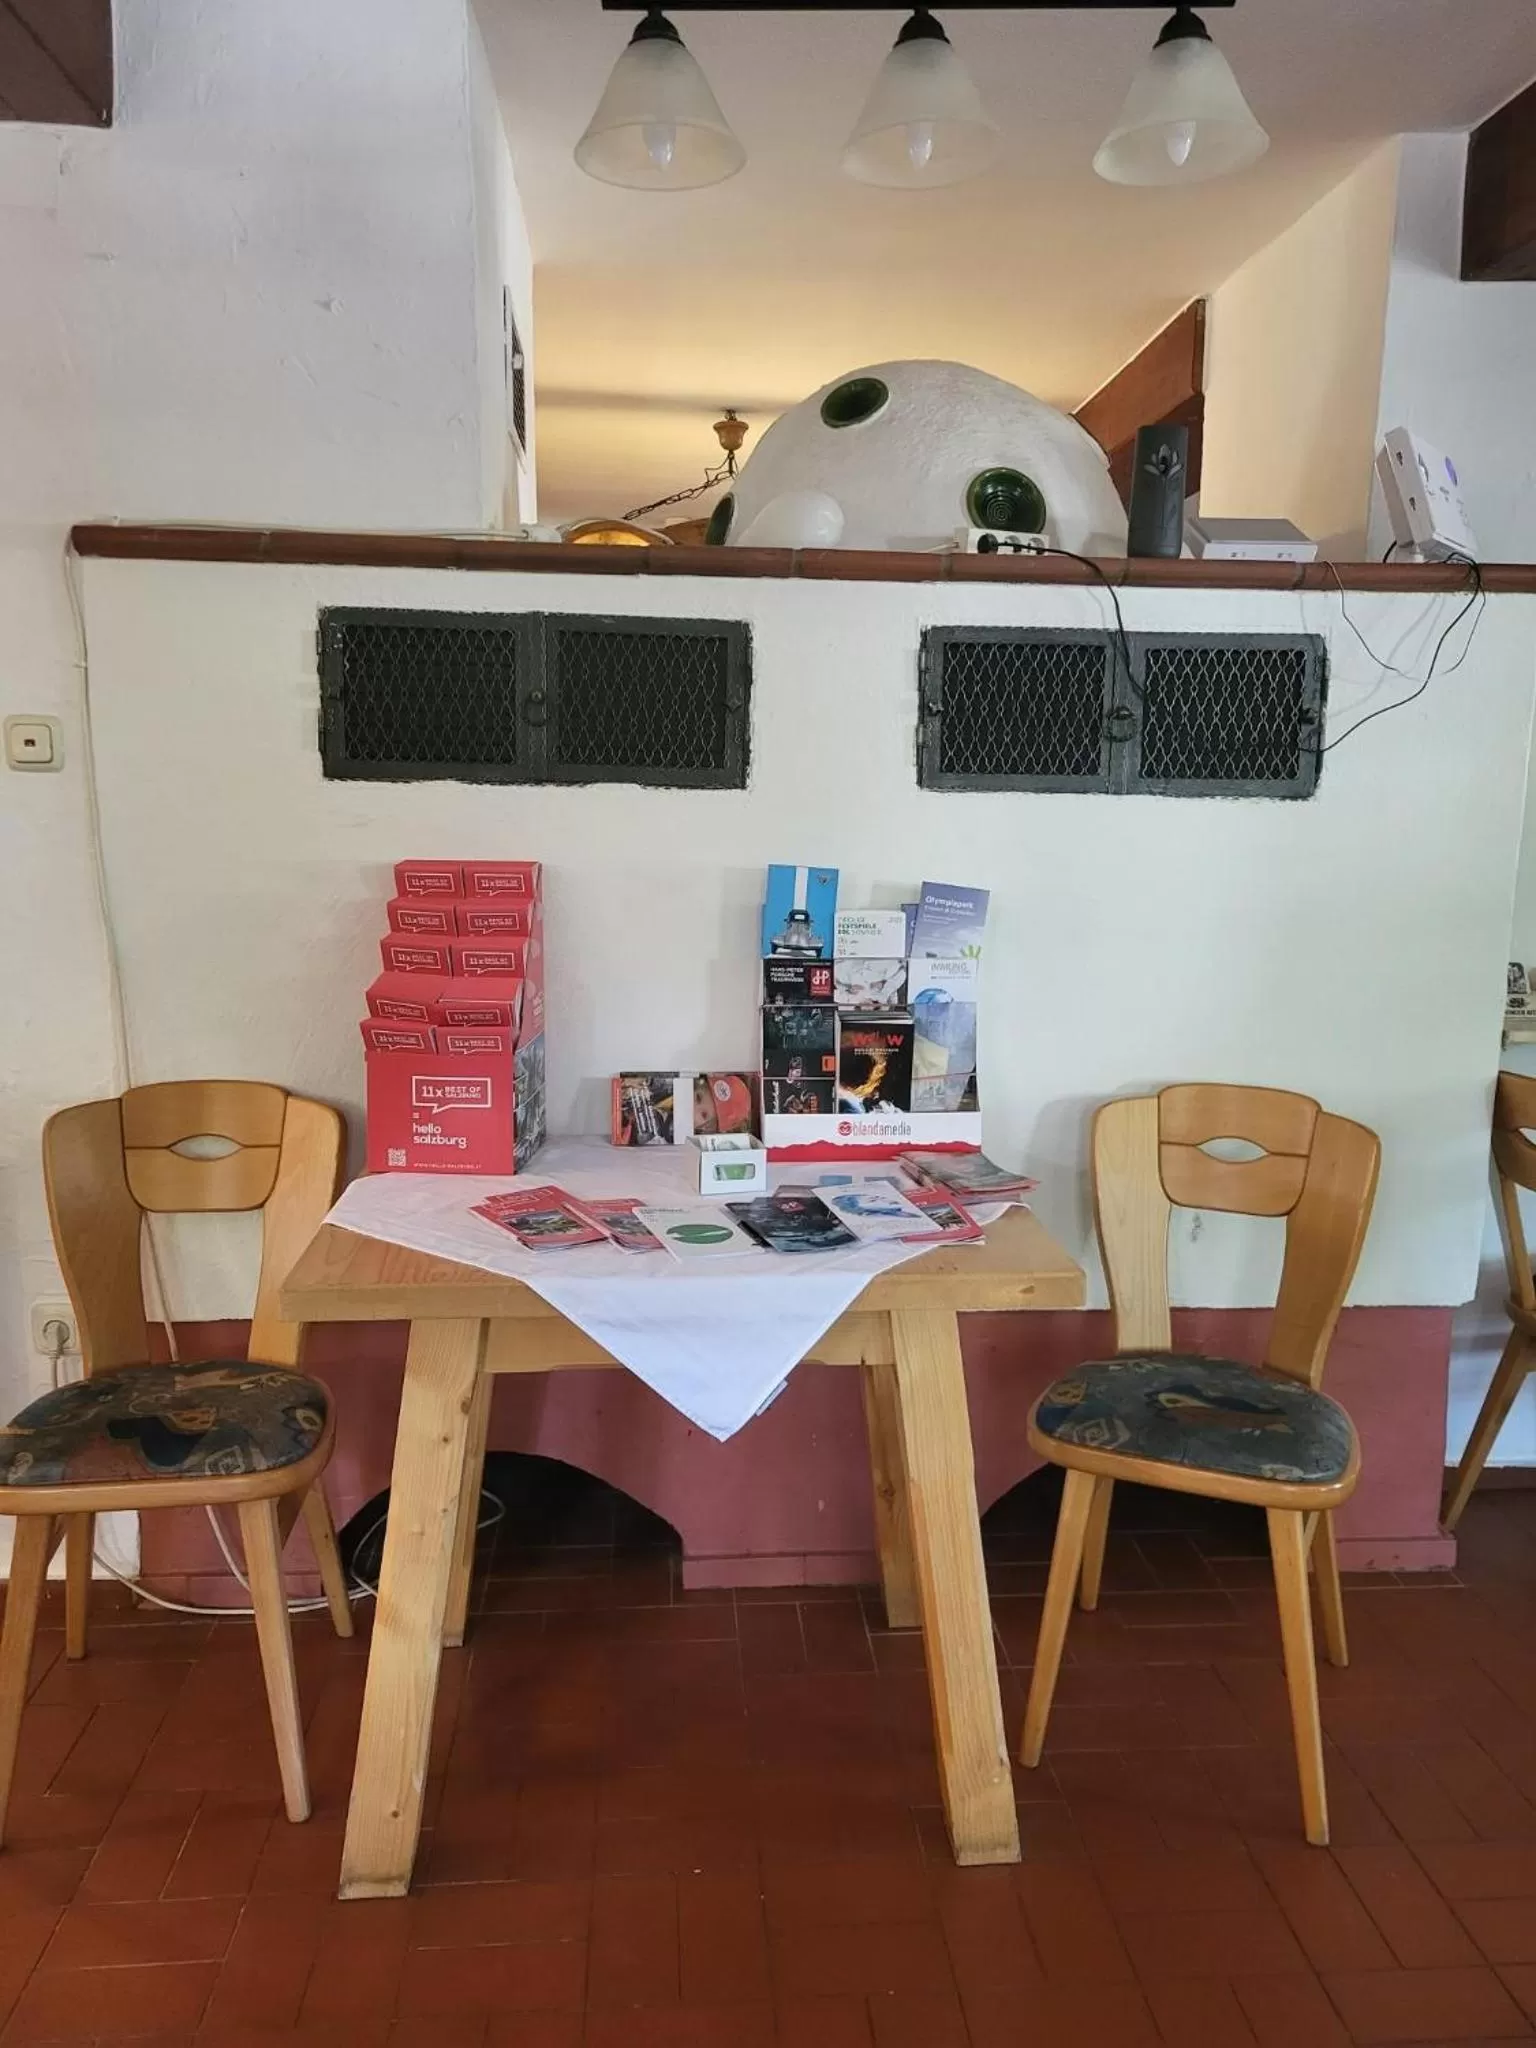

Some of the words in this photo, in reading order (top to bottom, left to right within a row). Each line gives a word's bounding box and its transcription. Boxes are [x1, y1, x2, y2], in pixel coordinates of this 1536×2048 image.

[422, 1085, 444, 1098] 11x
[412, 1122, 442, 1134] hello
[413, 1134, 467, 1149] salzburg
